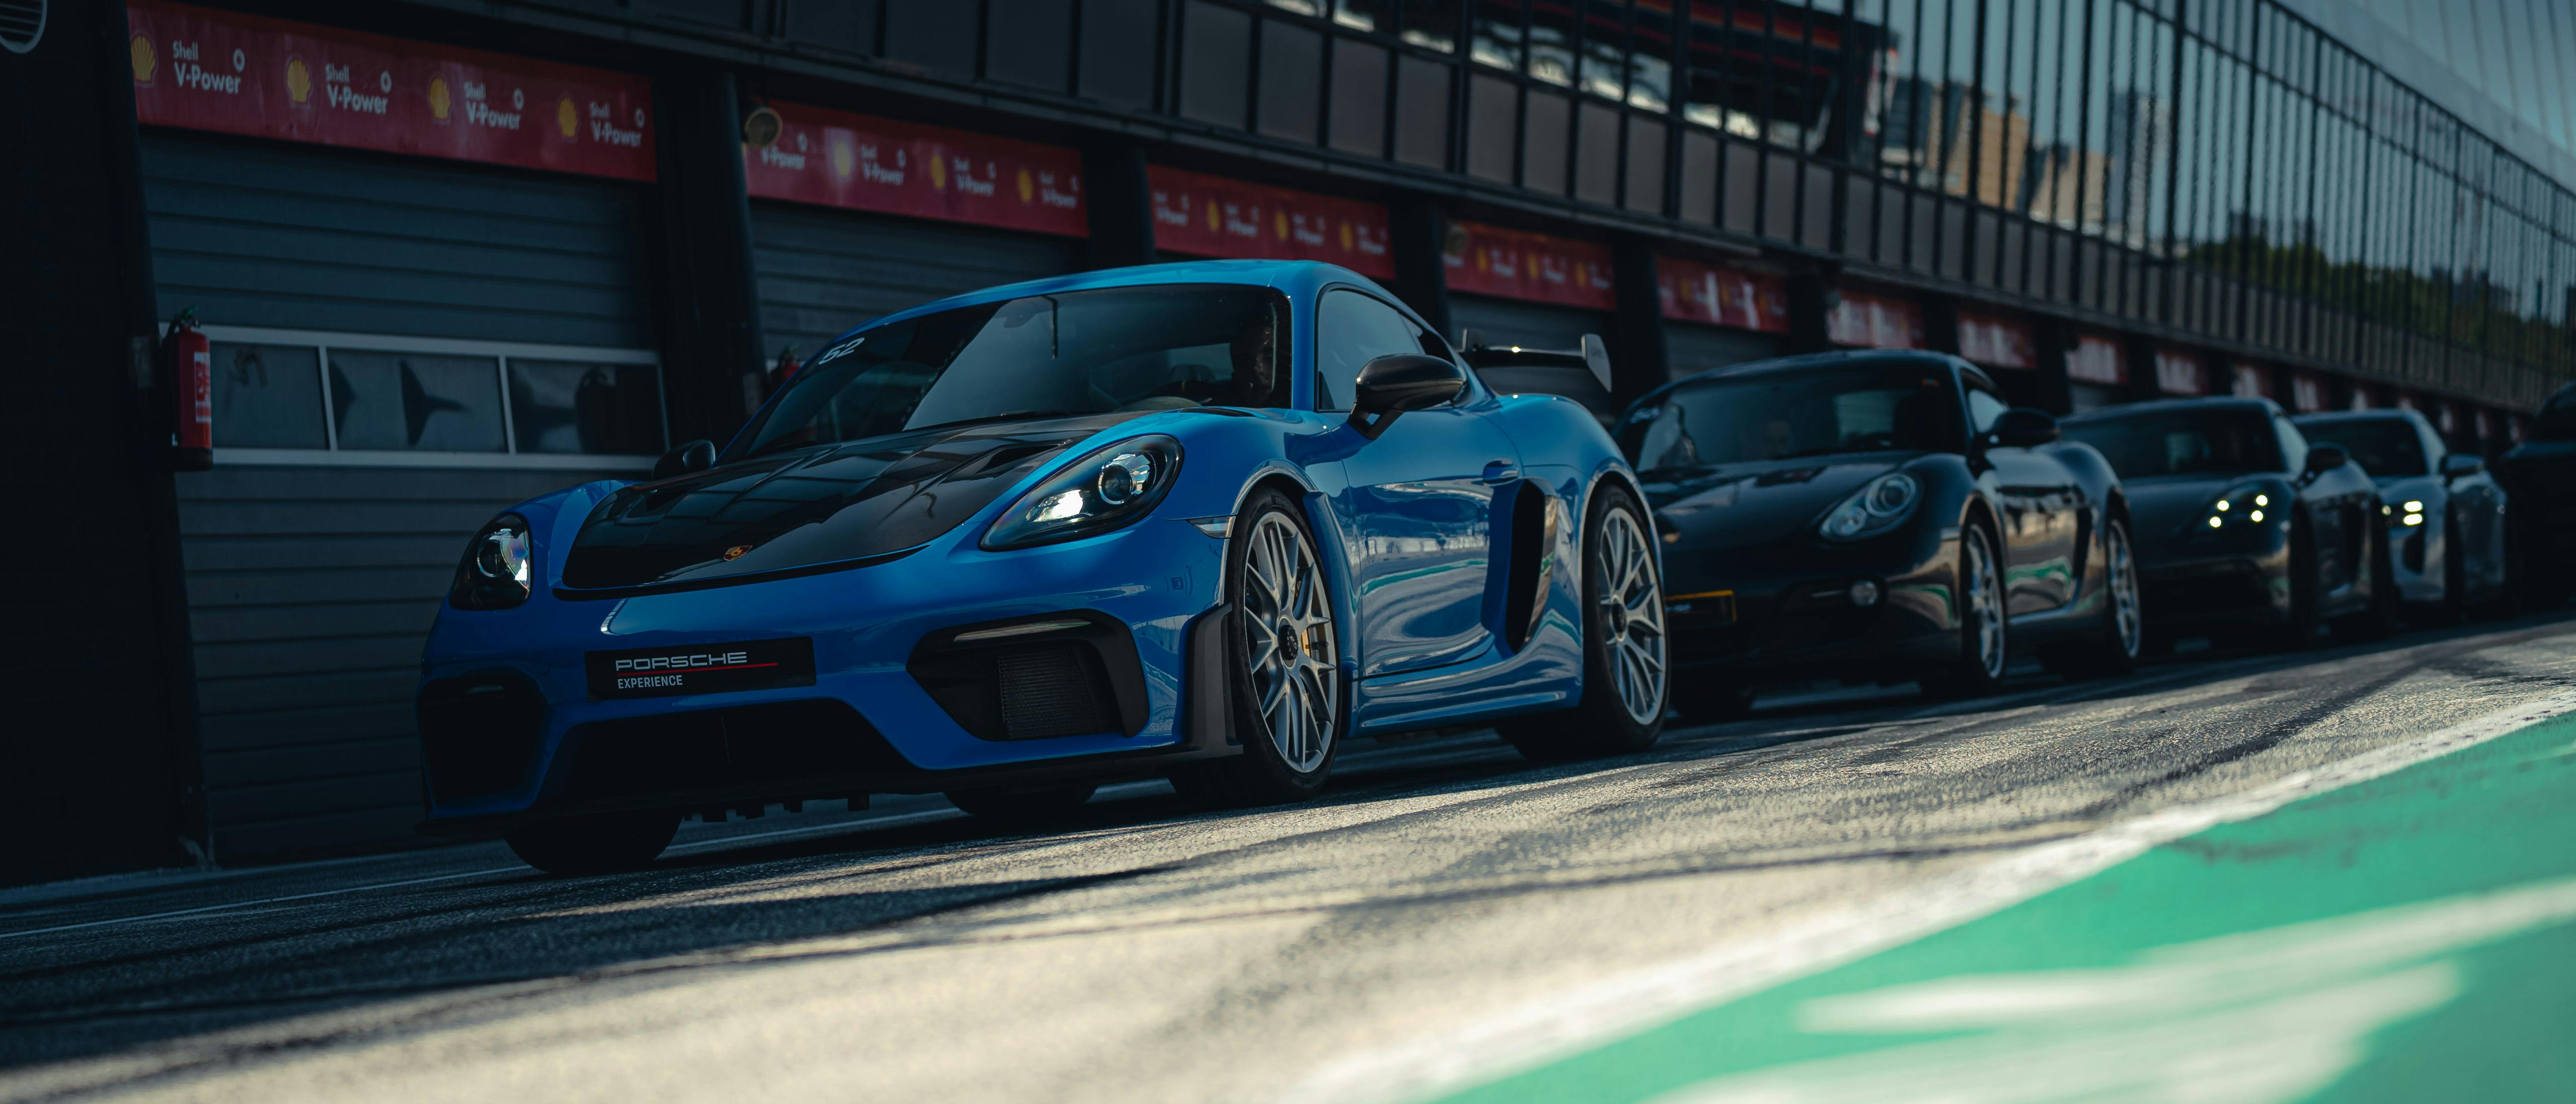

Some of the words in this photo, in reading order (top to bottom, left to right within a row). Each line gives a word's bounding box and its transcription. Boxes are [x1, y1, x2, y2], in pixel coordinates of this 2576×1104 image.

[173, 40, 199, 61] Shell
[174, 61, 242, 94] V-Power
[325, 63, 350, 83] Shell
[327, 83, 388, 115] V-Power
[463, 81, 487, 100] Shell
[465, 101, 521, 130] V-Power
[589, 101, 611, 118] Shell
[591, 120, 642, 147] V-Power
[818, 337, 865, 365] 52
[615, 652, 747, 671] PORSCHE
[617, 675, 683, 689] EXPERIENCE
